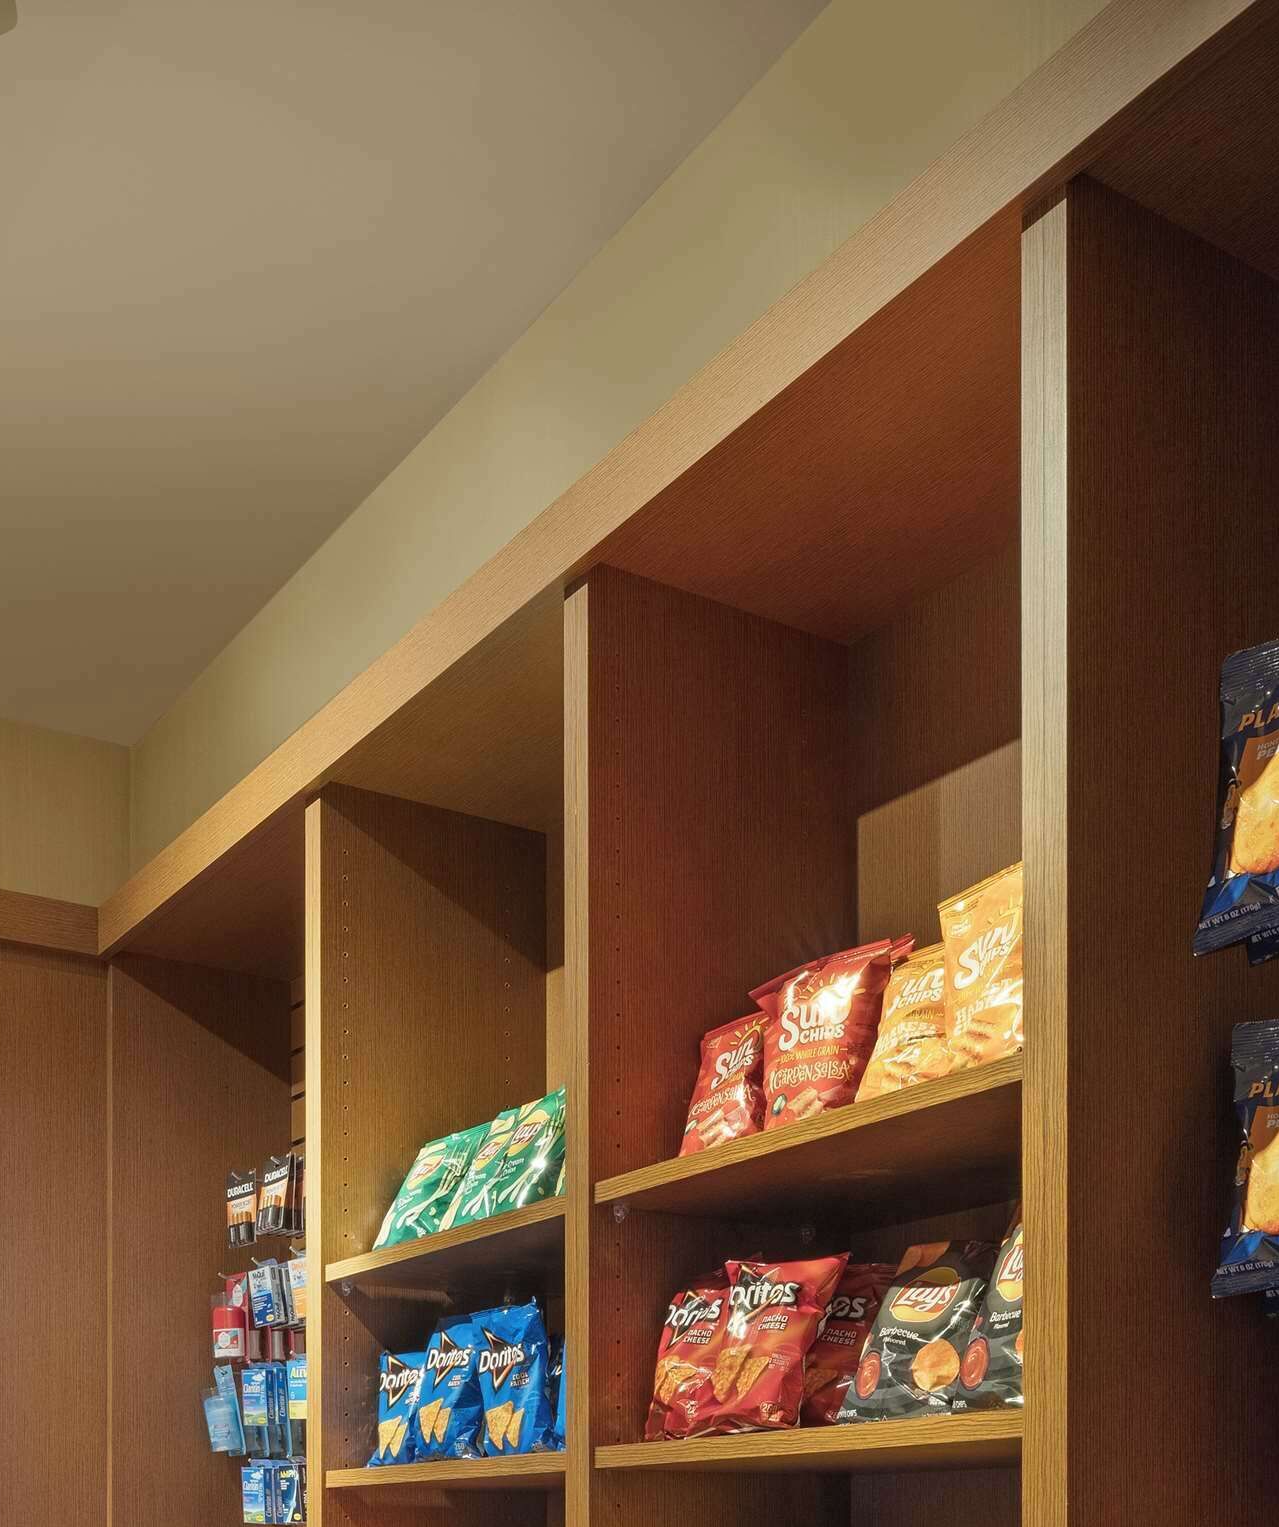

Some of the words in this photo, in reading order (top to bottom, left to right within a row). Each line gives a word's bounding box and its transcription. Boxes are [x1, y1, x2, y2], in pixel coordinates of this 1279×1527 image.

[799, 1022, 845, 1044] CHIPS
[818, 1045, 840, 1058] GRAIN
[227, 1181, 254, 1198] DURACELL
[894, 1285, 958, 1313] Lay's
[666, 1297, 721, 1327] Doritos
[761, 1314, 789, 1323] NACHO
[989, 1310, 1022, 1322] Barbecue
[757, 1321, 787, 1331] CHEESE
[682, 1335, 711, 1344] CHEESE
[687, 1328, 713, 1338] NACHO
[825, 1327, 858, 1339] NACHO
[879, 1326, 919, 1340] Barbecue
[821, 1335, 857, 1345] CHEESE
[427, 1347, 471, 1370] Doritos
[479, 1343, 525, 1371] Doritos
